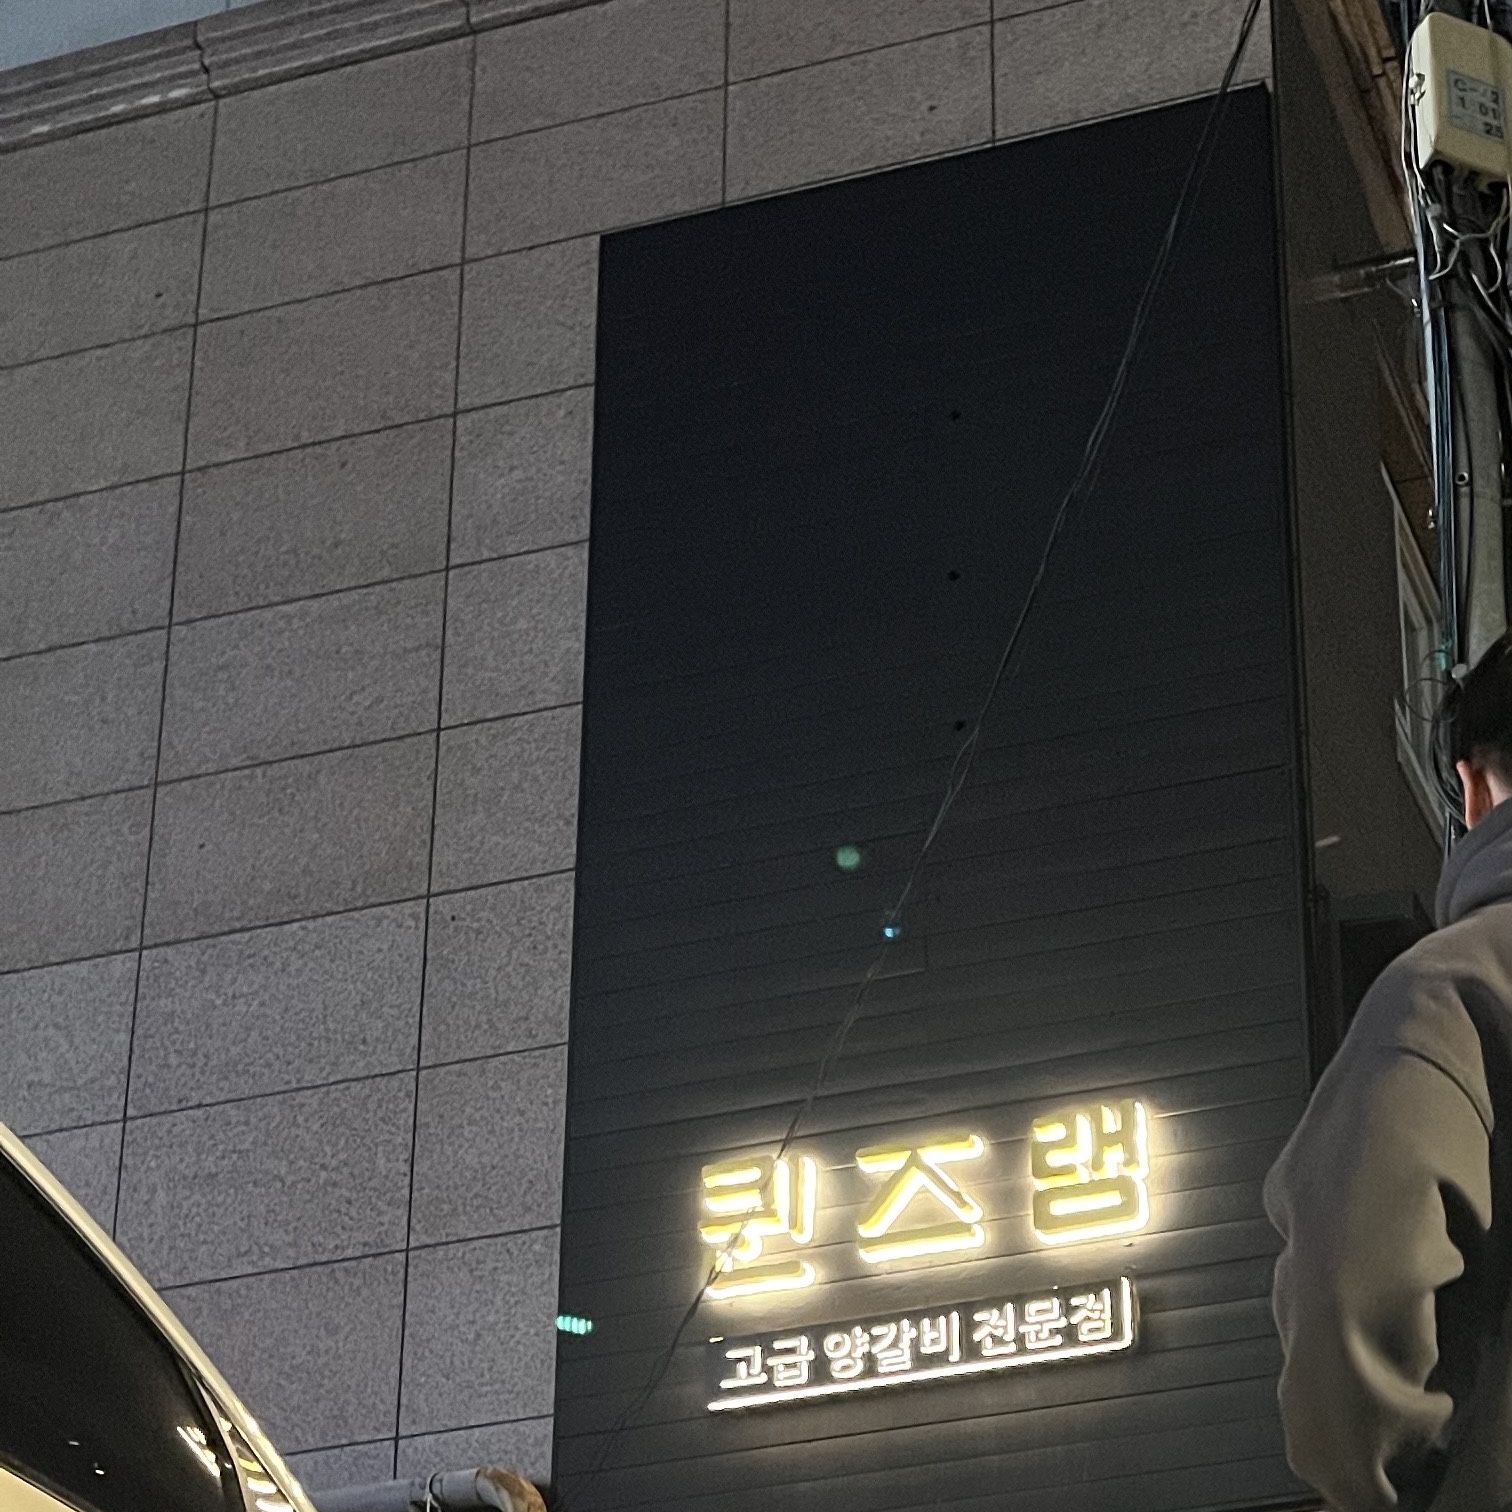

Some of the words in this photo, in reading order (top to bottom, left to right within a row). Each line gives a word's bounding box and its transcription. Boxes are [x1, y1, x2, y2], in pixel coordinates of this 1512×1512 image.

[720, 1334, 816, 1390] 고급
[824, 1310, 962, 1380] 양갈비
[972, 1287, 1114, 1358] 전문점
